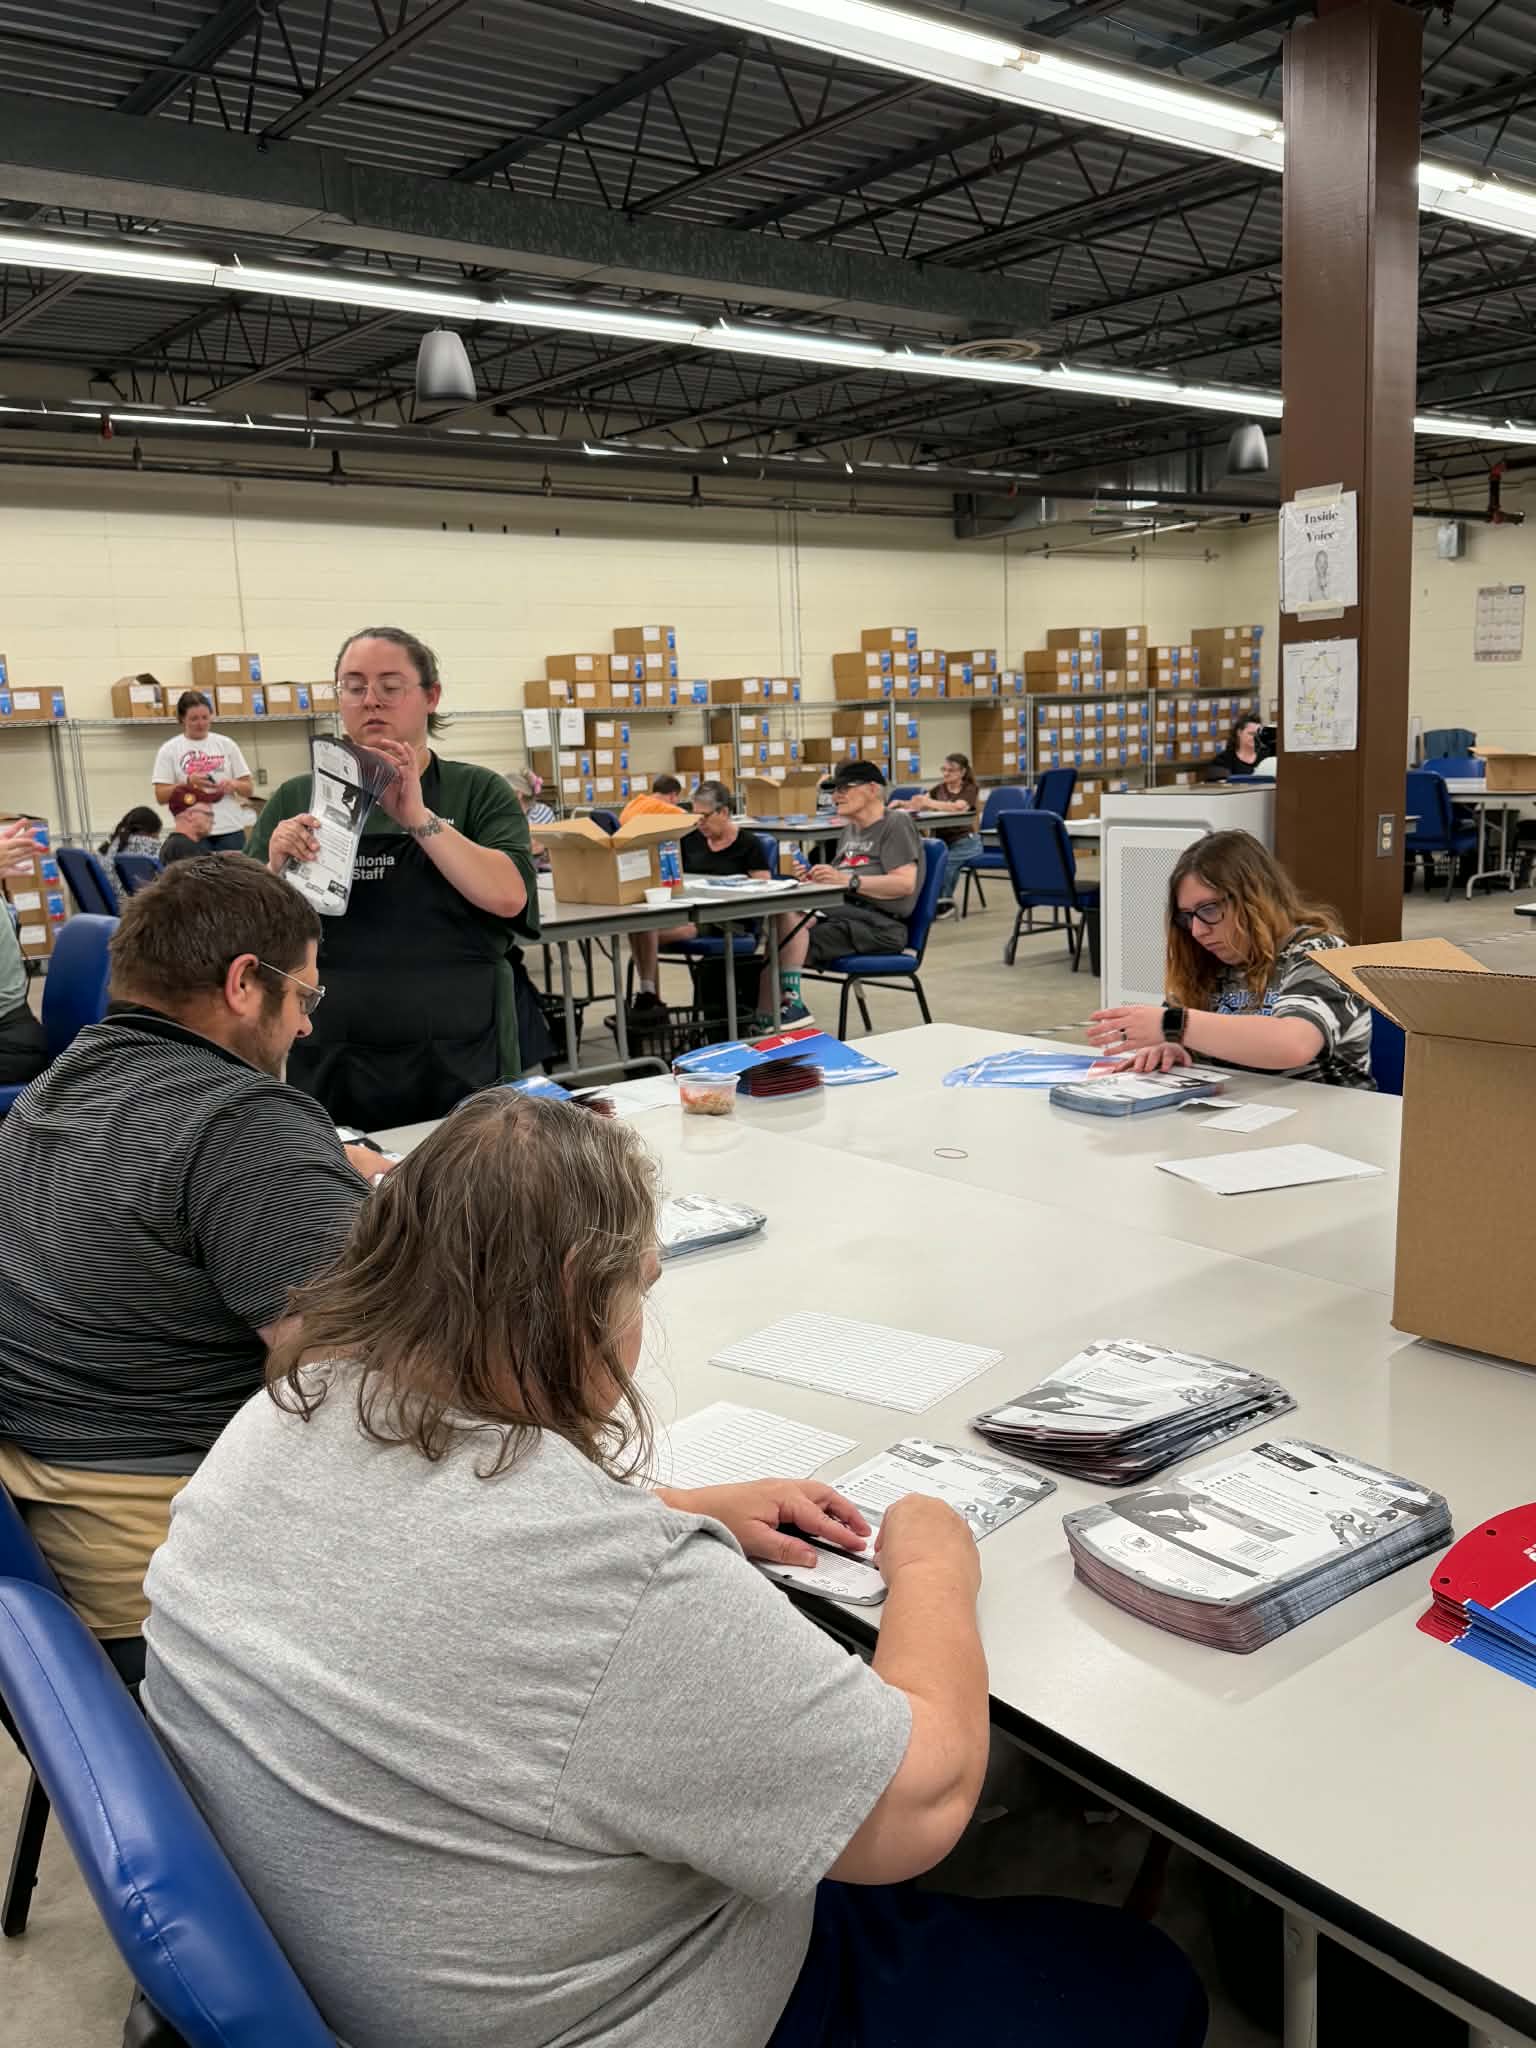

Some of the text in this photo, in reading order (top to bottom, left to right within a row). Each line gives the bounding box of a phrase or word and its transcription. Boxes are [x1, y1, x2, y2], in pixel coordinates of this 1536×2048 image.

[1304, 510, 1339, 524] Inside
[1306, 530, 1336, 542] Voice
[351, 866, 385, 880] Staff
